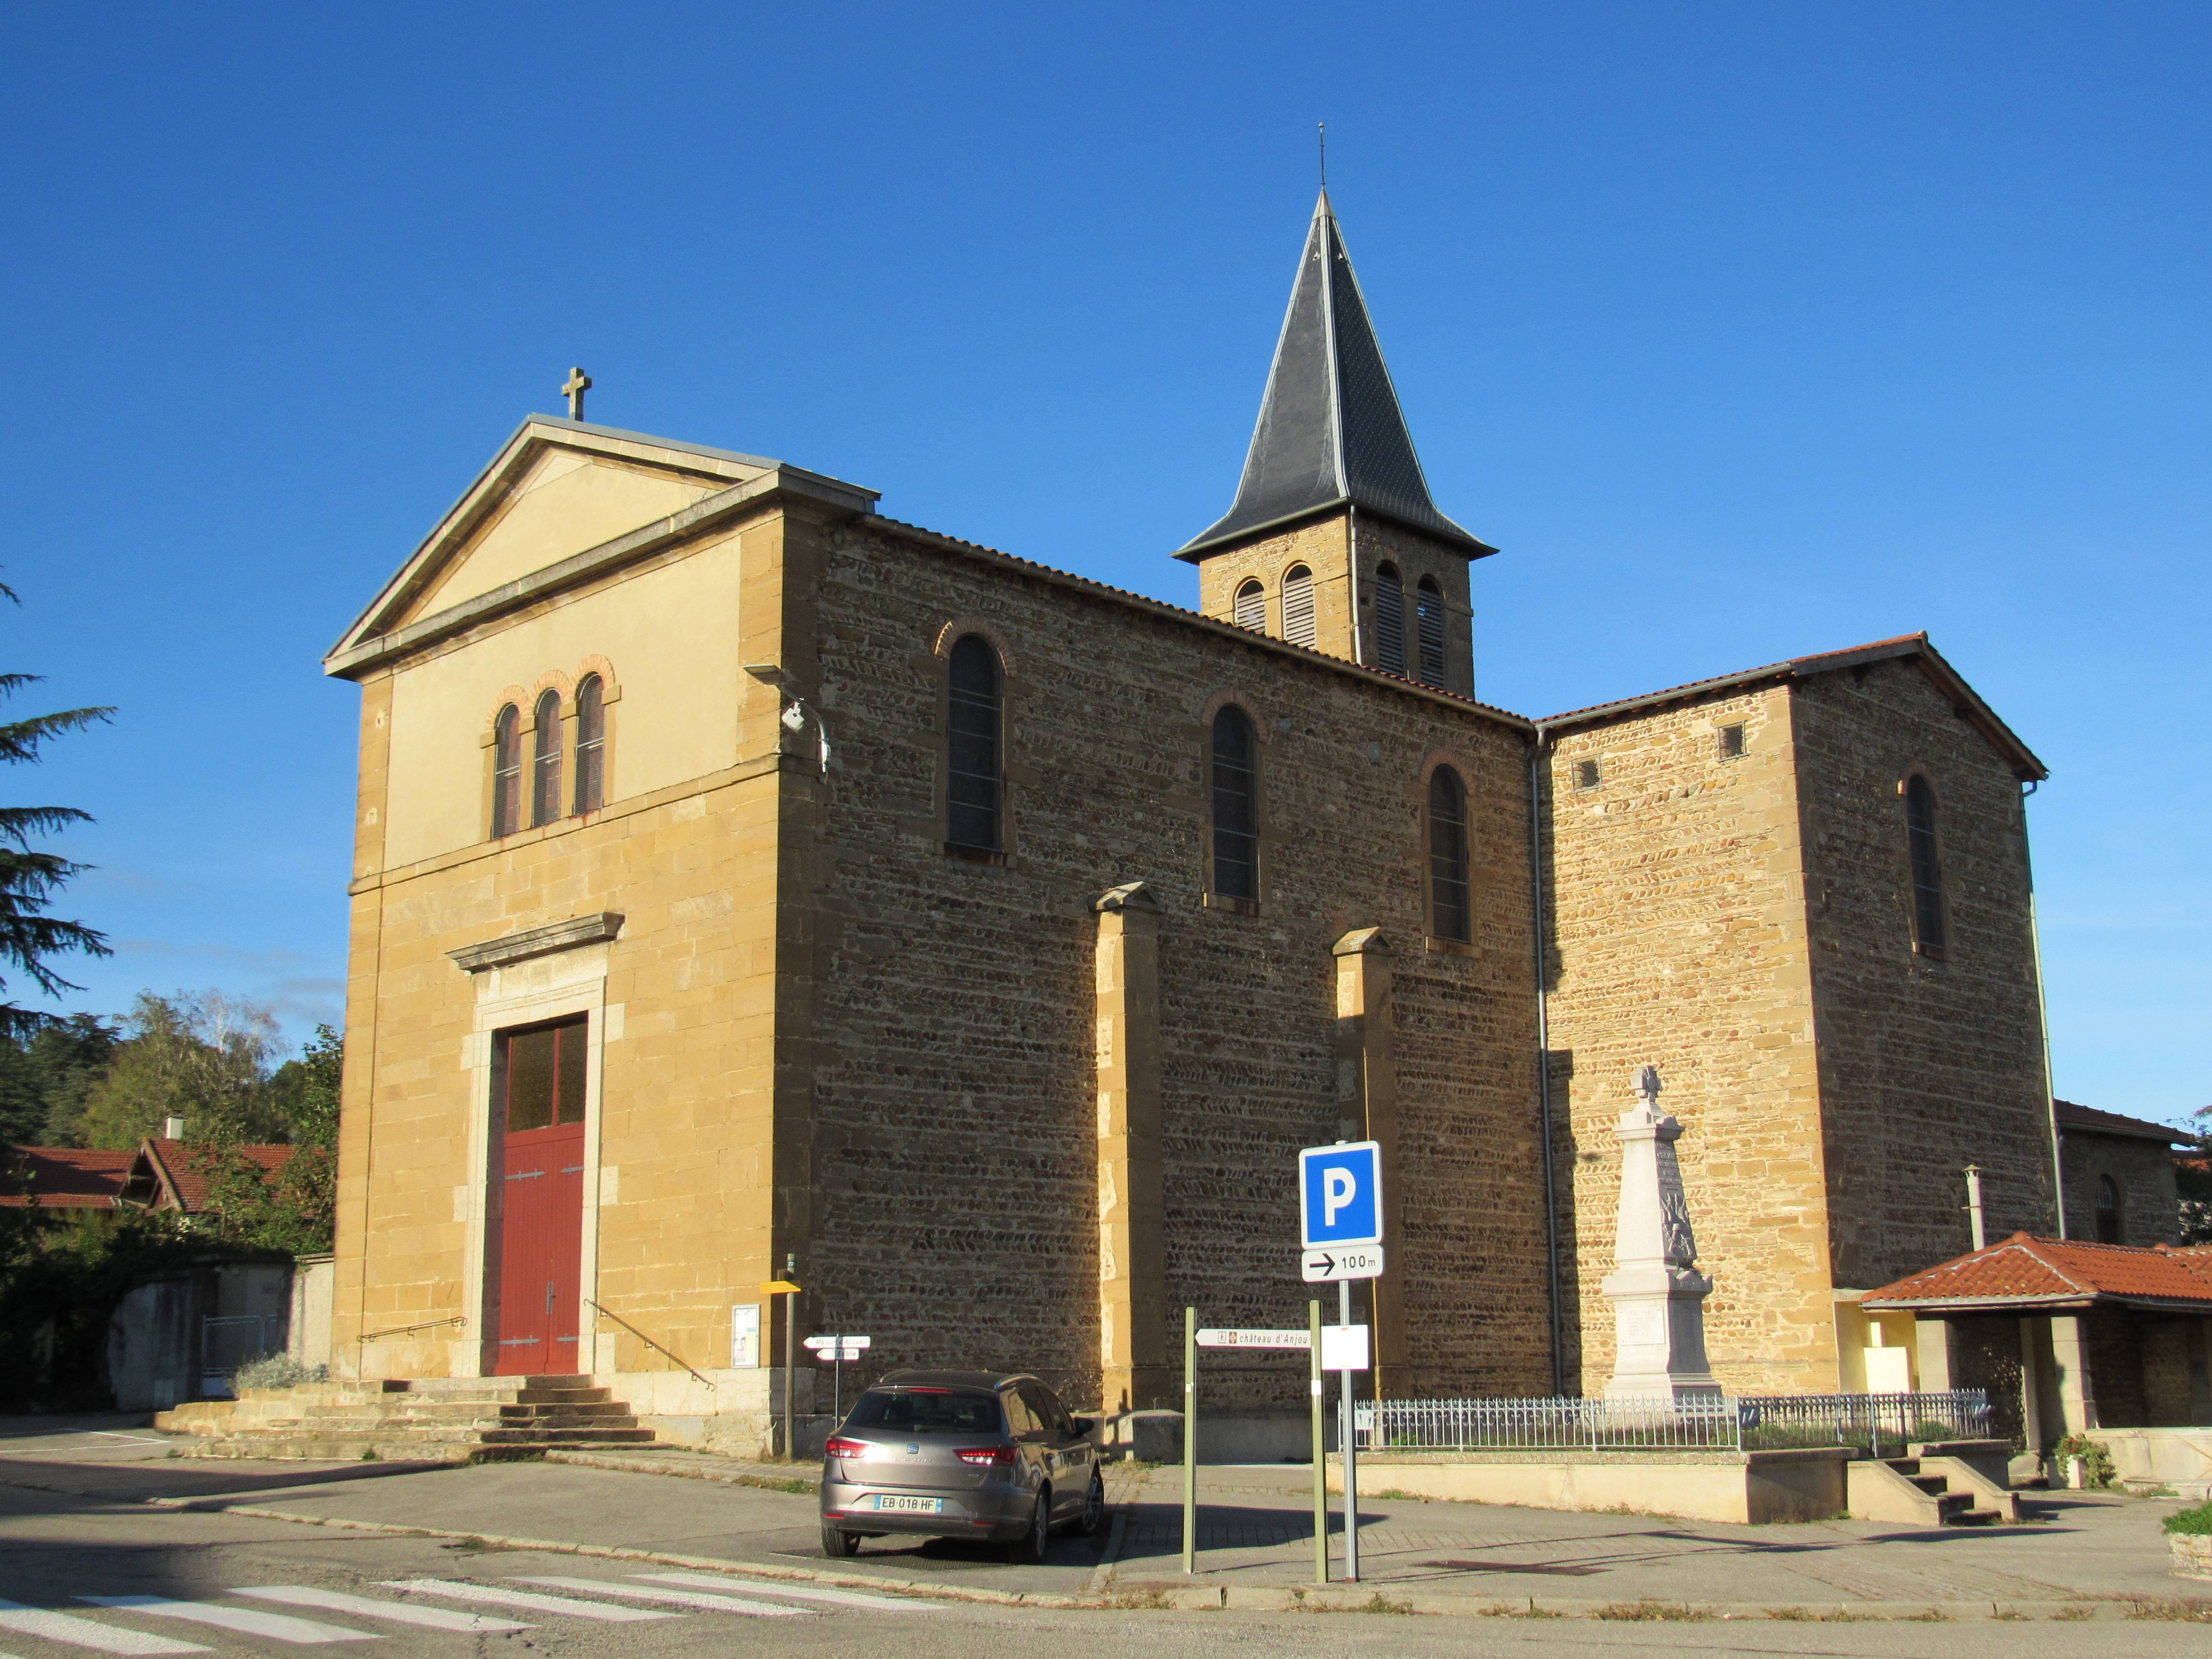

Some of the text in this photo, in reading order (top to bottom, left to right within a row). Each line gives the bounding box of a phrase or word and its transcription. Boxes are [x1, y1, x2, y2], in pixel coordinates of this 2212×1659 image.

[1323, 1167, 1356, 1226] P
[1239, 1333, 1308, 1346] château d'Anjou
